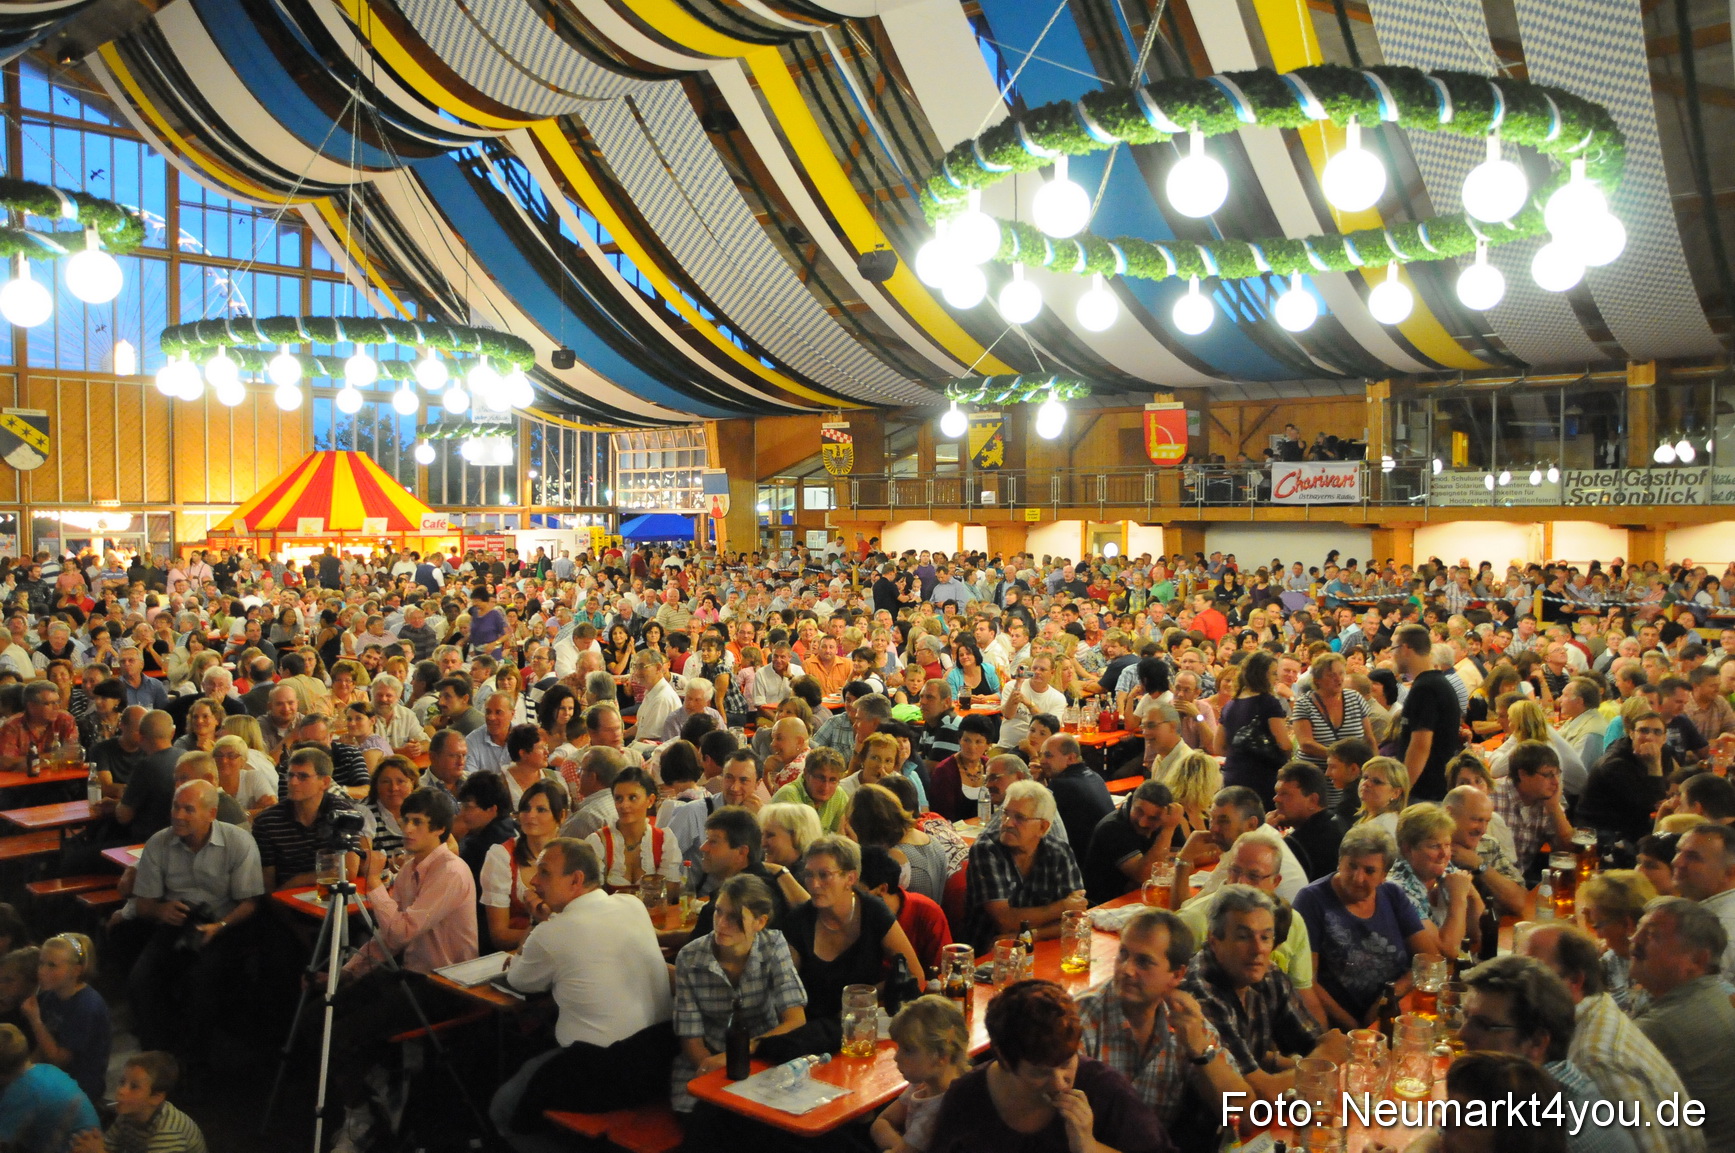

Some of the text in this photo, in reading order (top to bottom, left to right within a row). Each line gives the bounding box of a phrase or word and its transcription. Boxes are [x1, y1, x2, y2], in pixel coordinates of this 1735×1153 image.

[1273, 467, 1358, 498] Charivari
[1570, 487, 1698, 505] Schönblick
[422, 518, 447, 529] Café
